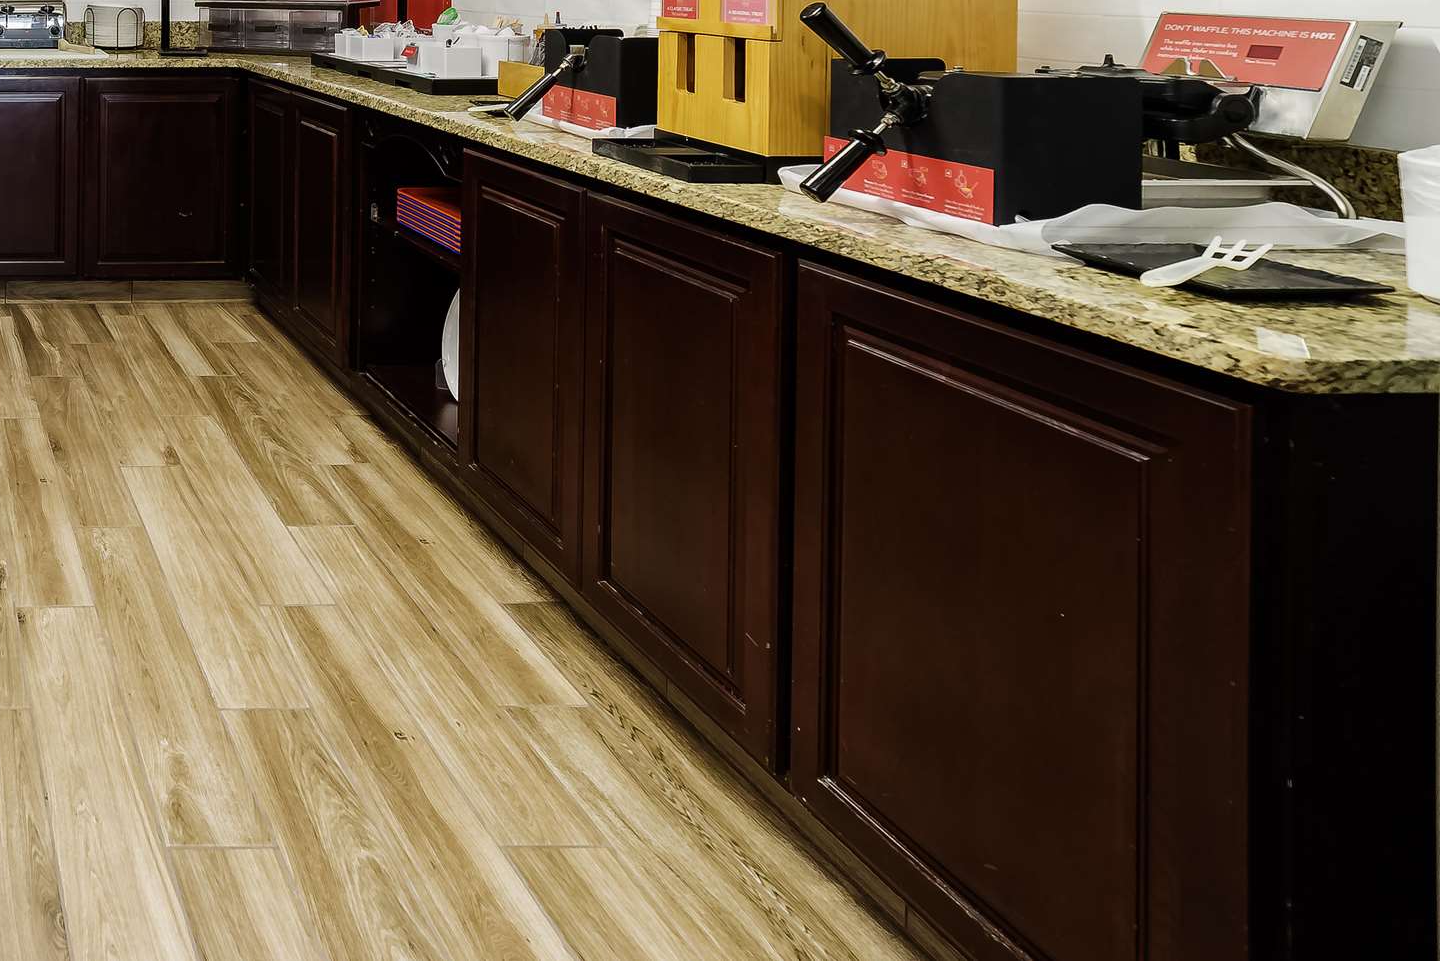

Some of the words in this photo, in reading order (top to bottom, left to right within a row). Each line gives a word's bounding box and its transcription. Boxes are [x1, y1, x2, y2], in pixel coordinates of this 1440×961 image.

[1164, 24, 1192, 32] DON'T
[1231, 27, 1251, 36] THIS
[1252, 29, 1299, 38] MACHINE
[1299, 31, 1310, 39] IS
[1310, 32, 1336, 40] HOT.
